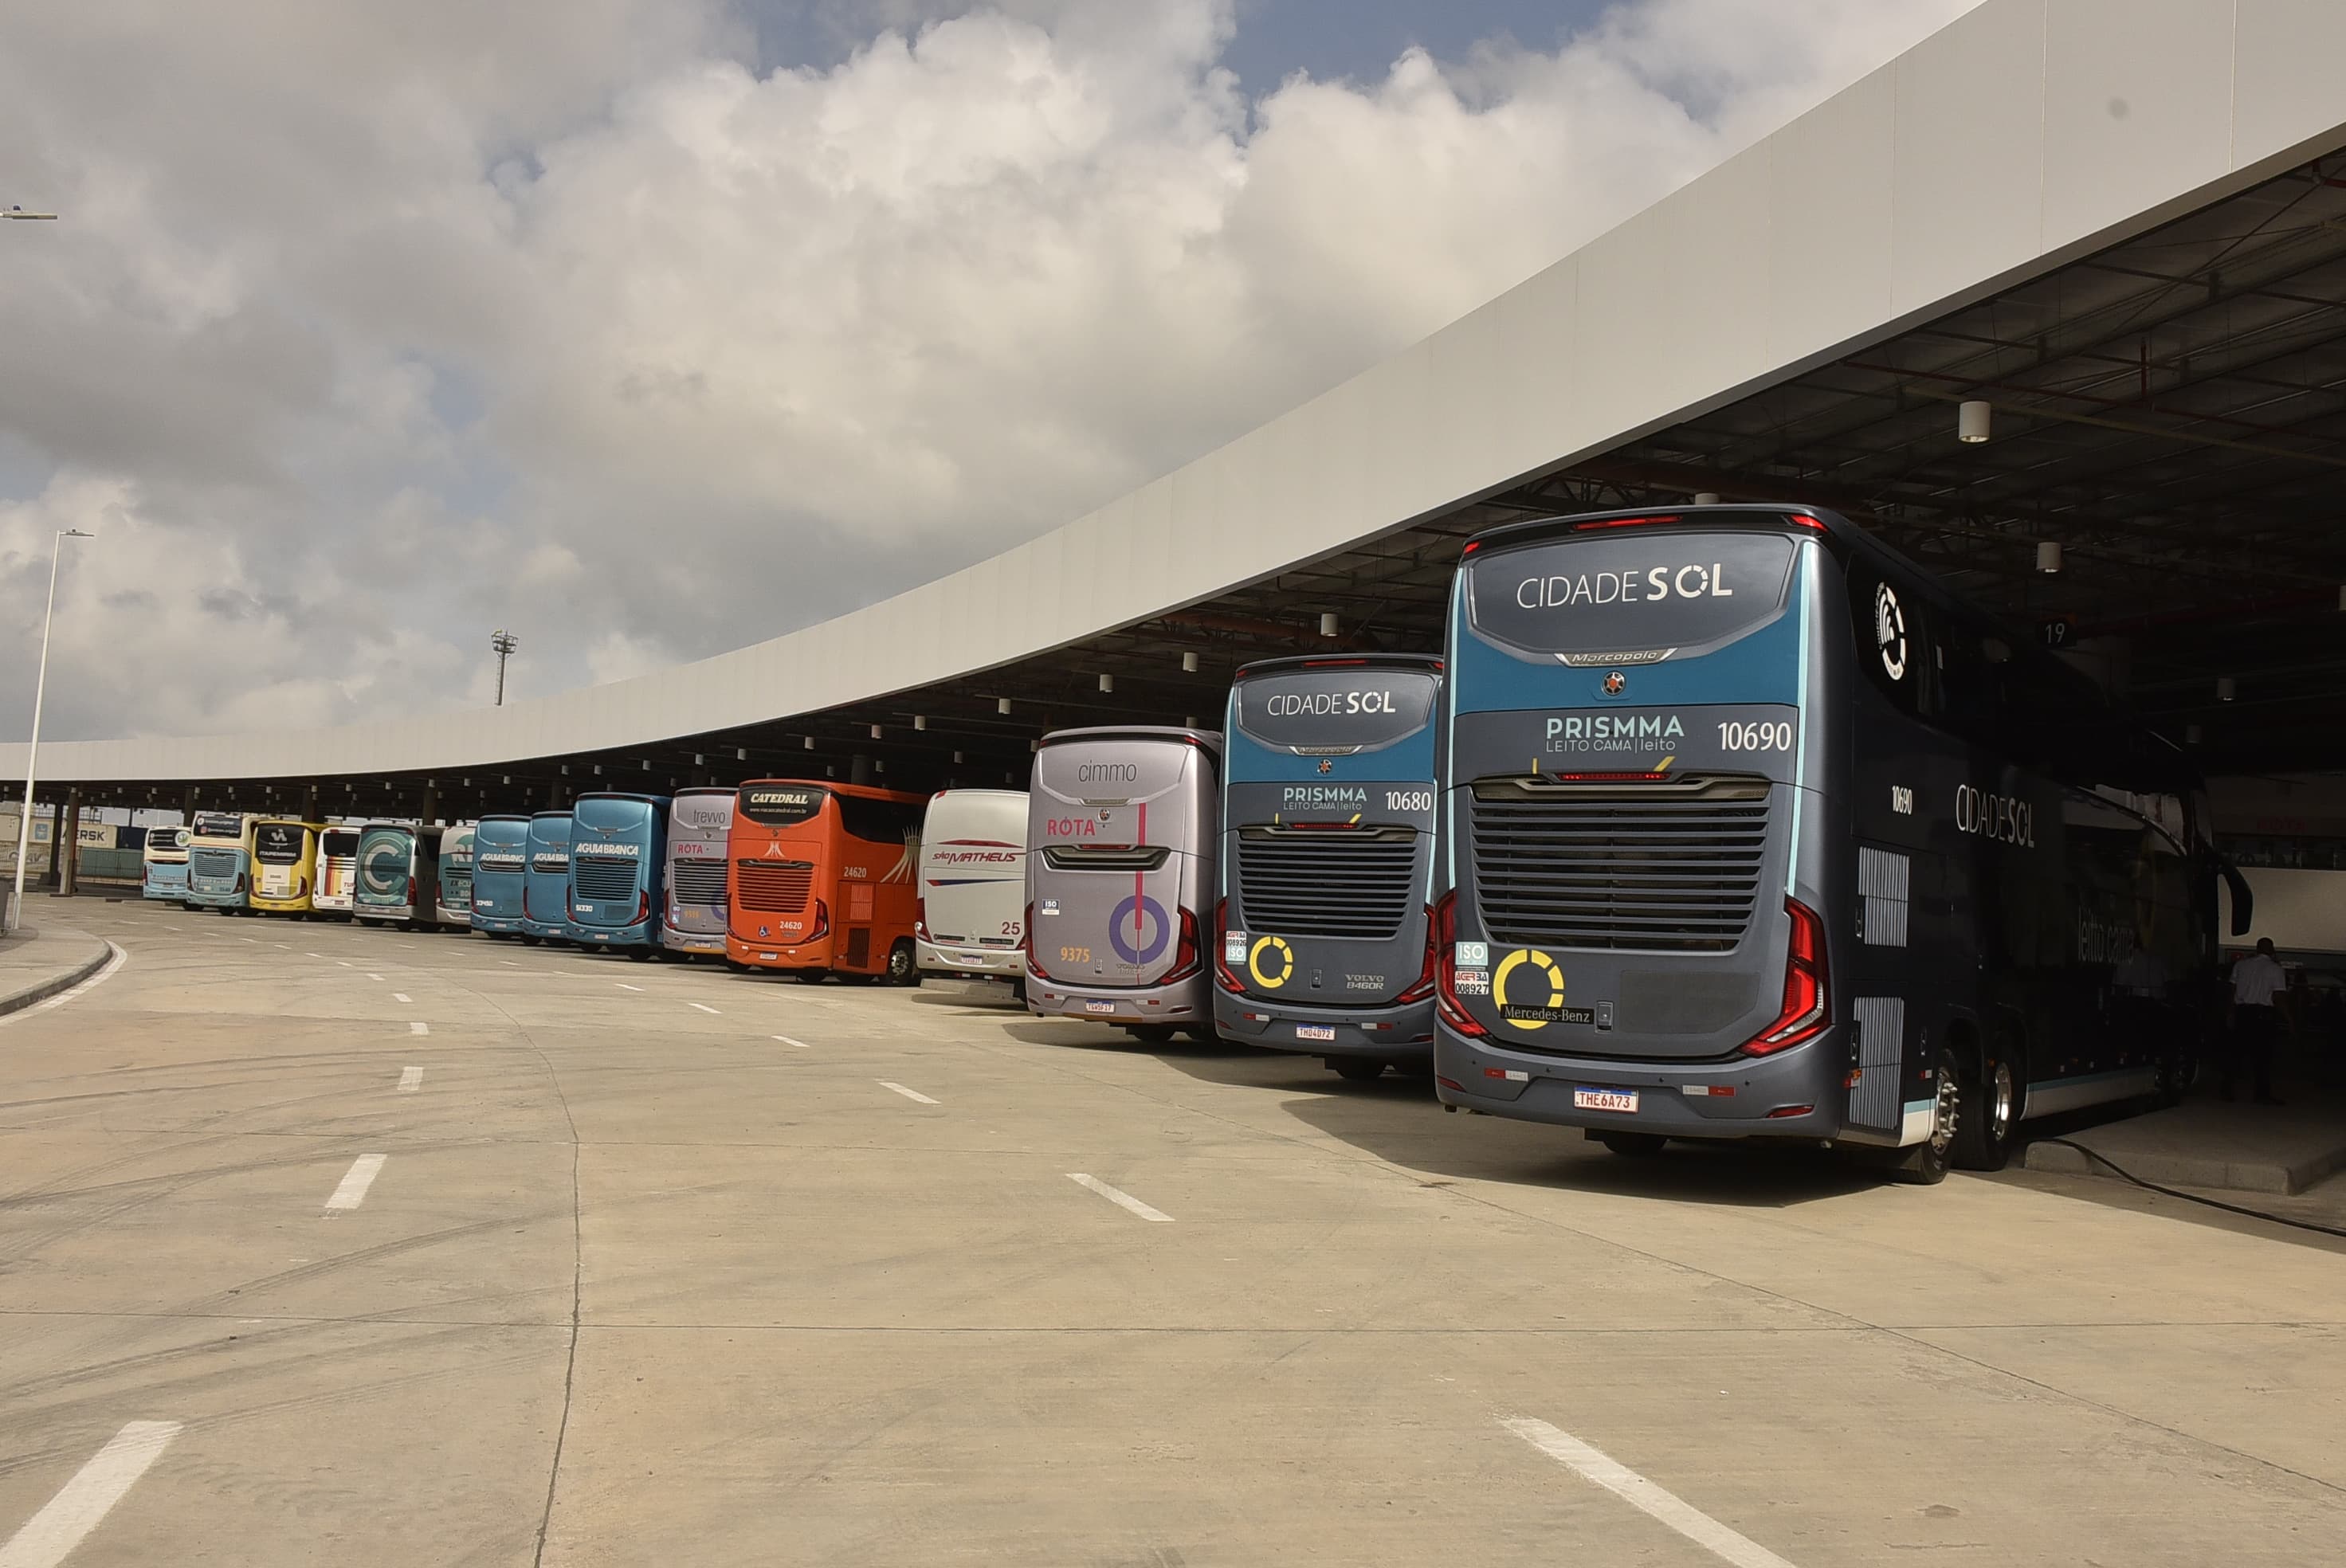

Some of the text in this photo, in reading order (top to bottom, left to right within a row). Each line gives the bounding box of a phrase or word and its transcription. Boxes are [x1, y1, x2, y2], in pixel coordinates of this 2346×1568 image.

[1516, 563, 1733, 609] CIDADE SOL
[2045, 623, 2066, 644] 19
[1571, 650, 1658, 662] Marcopolo
[1267, 691, 1396, 716] CIDADE SOL
[1546, 715, 1685, 739] PRISMMA
[1716, 722, 1793, 751] 10690
[1546, 738, 1676, 753] LEITO CAMA leito
[1078, 759, 1137, 782] cimmo
[751, 794, 808, 805] CATEDRAL
[1284, 787, 1367, 802] PRISMMA
[1385, 791, 1431, 811] 10680
[1892, 785, 1912, 816] 10690
[1283, 801, 1363, 810] LEITO CAMA leito
[693, 809, 726, 824] trevvo
[1956, 783, 2034, 849] CIDADE SOL
[1046, 817, 1096, 836] ROTA
[678, 844, 703, 854] ROTA
[947, 853, 1017, 865] MATHEUS
[844, 866, 867, 878] 24620
[779, 920, 802, 931] 24620
[1001, 922, 1021, 935] 25
[1060, 947, 1091, 963] 9375
[1228, 947, 1244, 958] ISO
[1460, 944, 1485, 959] ISO
[1455, 983, 1489, 994] 008927
[1504, 1005, 1590, 1023] Mercedes-Benz
[1579, 1092, 1630, 1109] THE6A73
